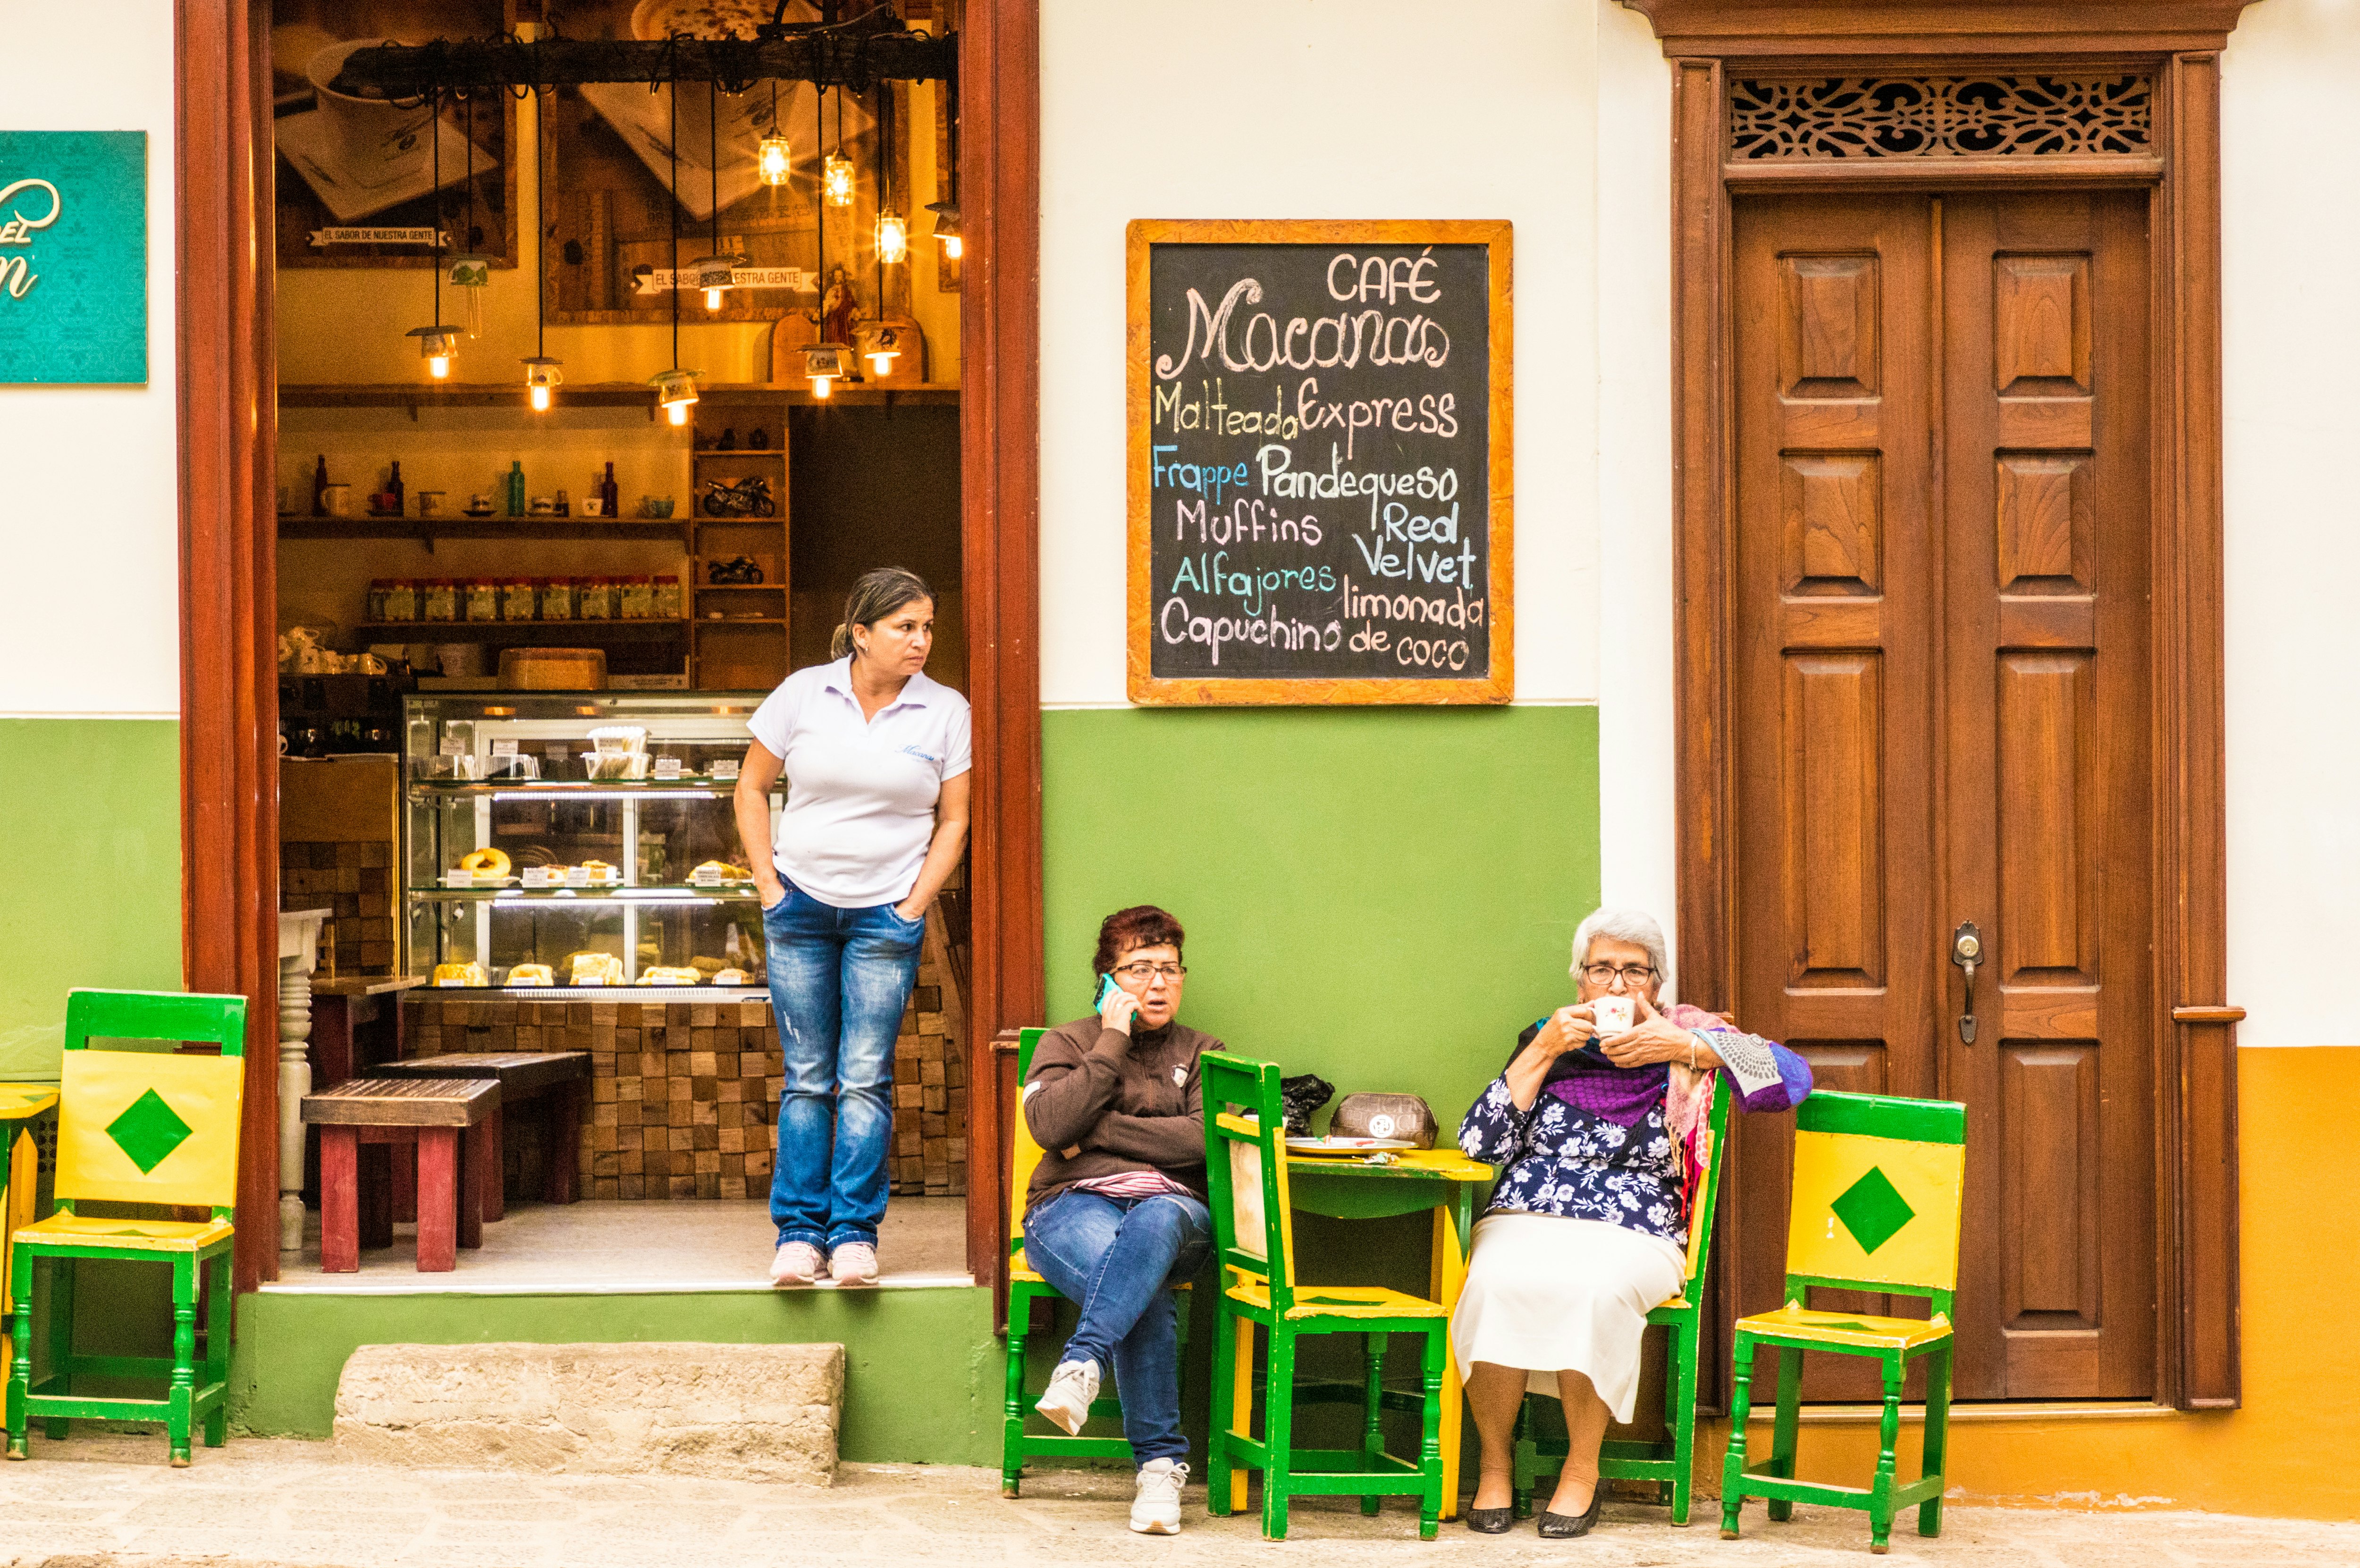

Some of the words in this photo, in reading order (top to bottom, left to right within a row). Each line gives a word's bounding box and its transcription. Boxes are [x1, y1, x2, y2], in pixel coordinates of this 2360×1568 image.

[324, 230, 331, 239] EL
[335, 230, 360, 239] SABOR
[362, 230, 371, 239] DE
[373, 230, 407, 239] NUESTRA
[409, 230, 433, 239] GENTE
[656, 273, 667, 285] EL
[670, 273, 699, 285] SABO
[767, 271, 799, 284] GENTE
[1327, 246, 1441, 305] CAFÉ
[1156, 378, 1299, 439] Malteada
[1298, 378, 1458, 460] Express
[1154, 445, 1247, 504] Frappe
[1256, 442, 1458, 530] Pandequeso
[1177, 499, 1322, 545] Muffins
[1383, 502, 1458, 543] Red
[1172, 551, 1336, 616] Alfajores
[1352, 534, 1476, 588] Velvet
[1344, 574, 1483, 629] limonada
[1161, 597, 1341, 665] Capuchino
[1349, 620, 1391, 653] de
[1397, 637, 1468, 671] coco
